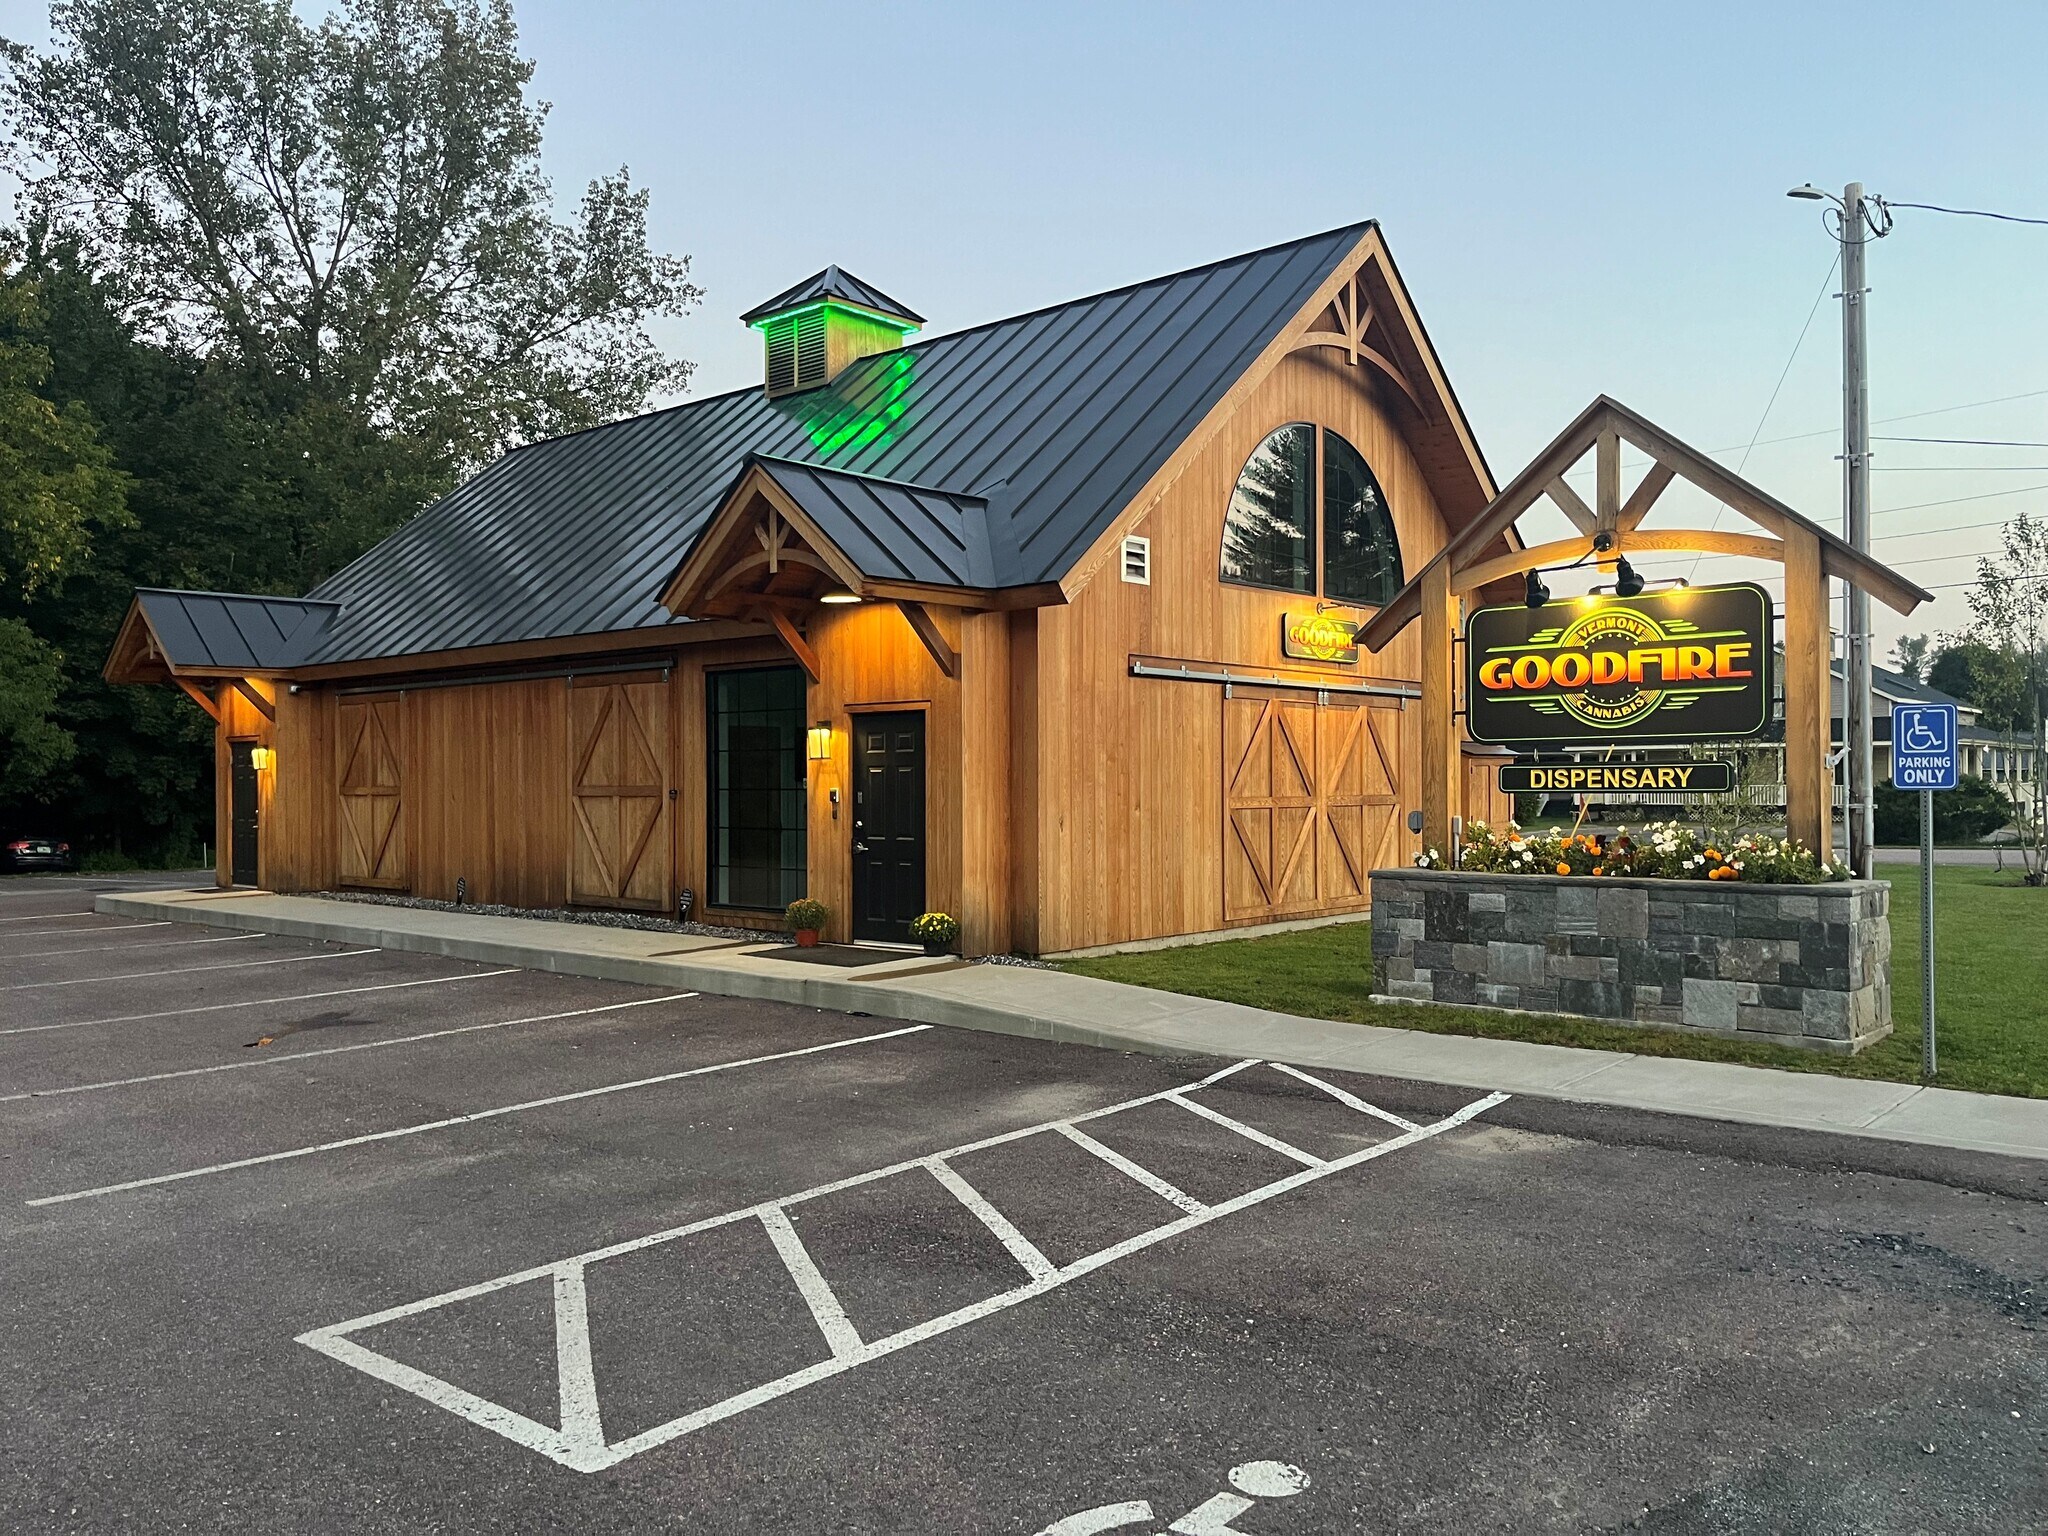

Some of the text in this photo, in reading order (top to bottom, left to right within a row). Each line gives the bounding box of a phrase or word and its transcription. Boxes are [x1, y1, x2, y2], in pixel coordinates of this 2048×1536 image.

[1577, 617, 1646, 638] VERMONT
[1479, 642, 1753, 690] GOODFIRE
[1576, 697, 1645, 719] CANNABIS
[1898, 756, 1951, 768] PARKING
[1530, 767, 1694, 789] DISPENSARY
[1903, 769, 1946, 784] ONLY
